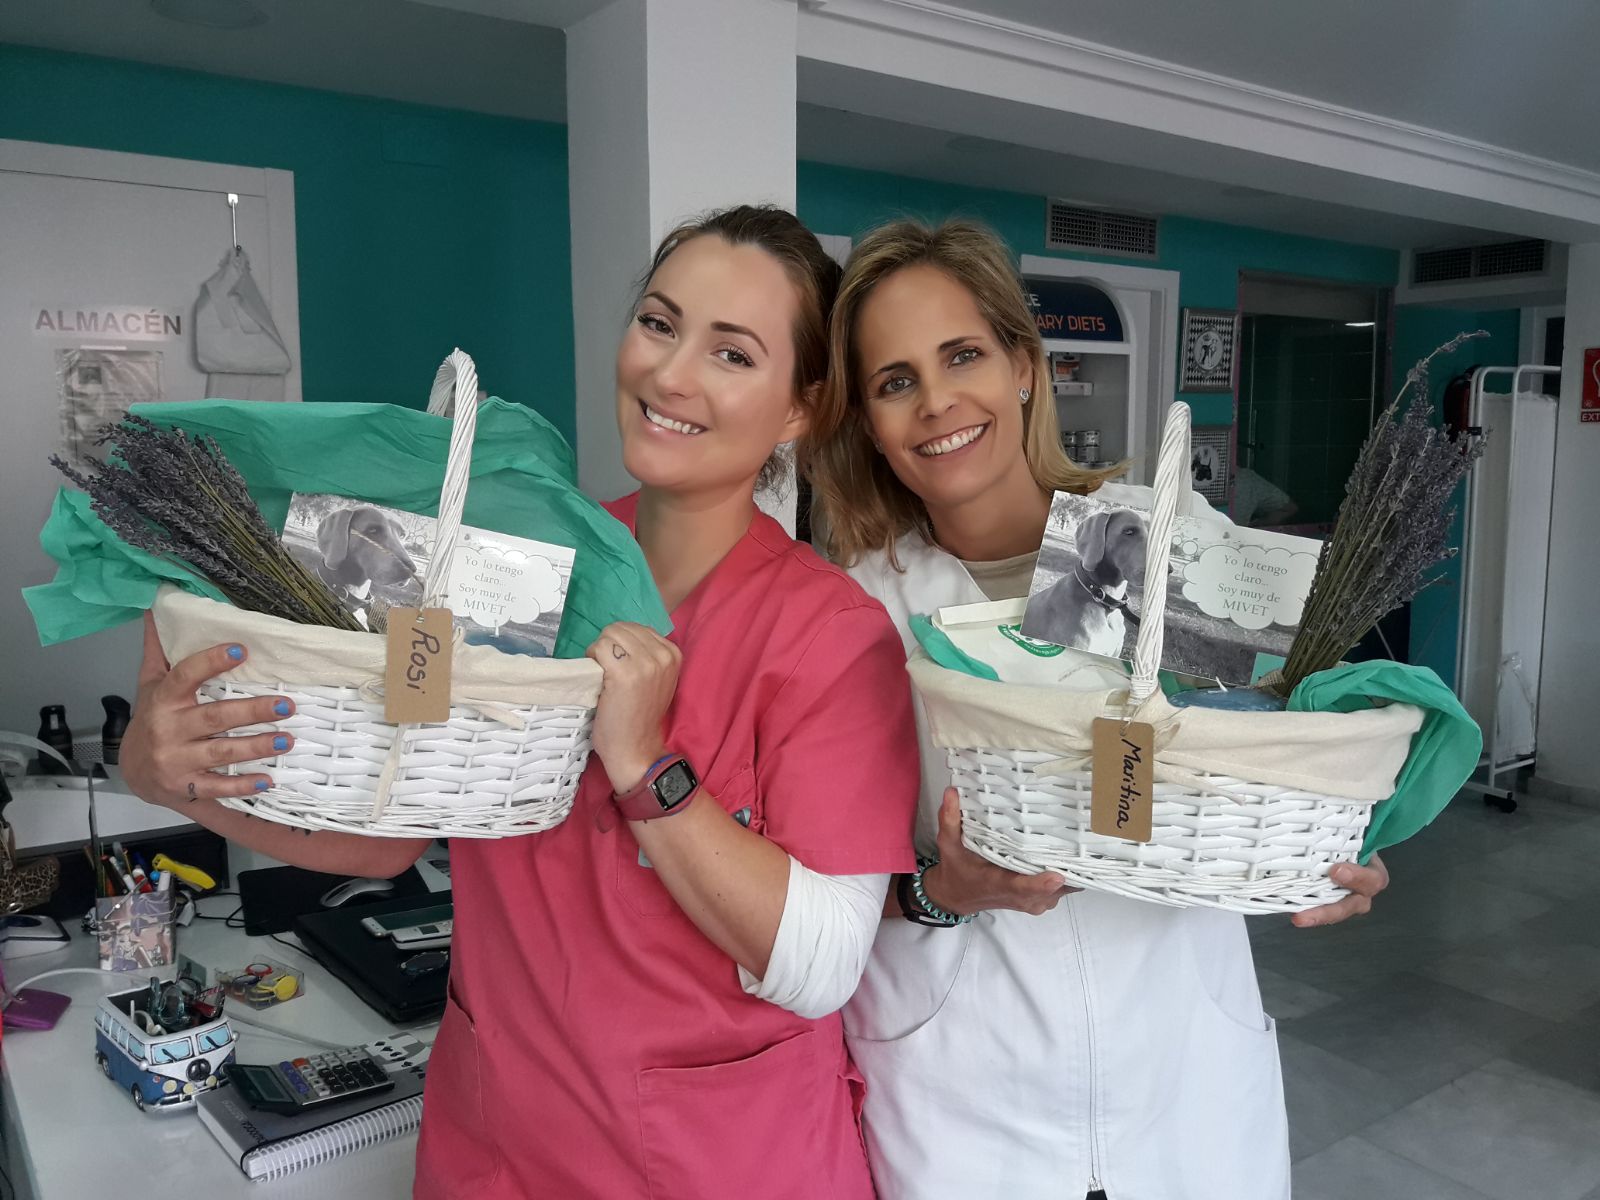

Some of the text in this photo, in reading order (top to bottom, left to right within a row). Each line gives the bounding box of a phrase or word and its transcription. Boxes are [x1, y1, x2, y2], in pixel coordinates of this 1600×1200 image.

[35, 309, 182, 335] ALMACÉN
[1067, 315, 1106, 332] DIETS
[465, 555, 523, 577] Yo lo tengo
[1224, 554, 1288, 576] Yo lo tengo
[458, 583, 517, 603] Soy muy de
[1217, 583, 1281, 603] Soy muy de
[463, 598, 506, 615] MIVET
[1222, 599, 1269, 617] MIVET
[406, 627, 440, 694] Rosi
